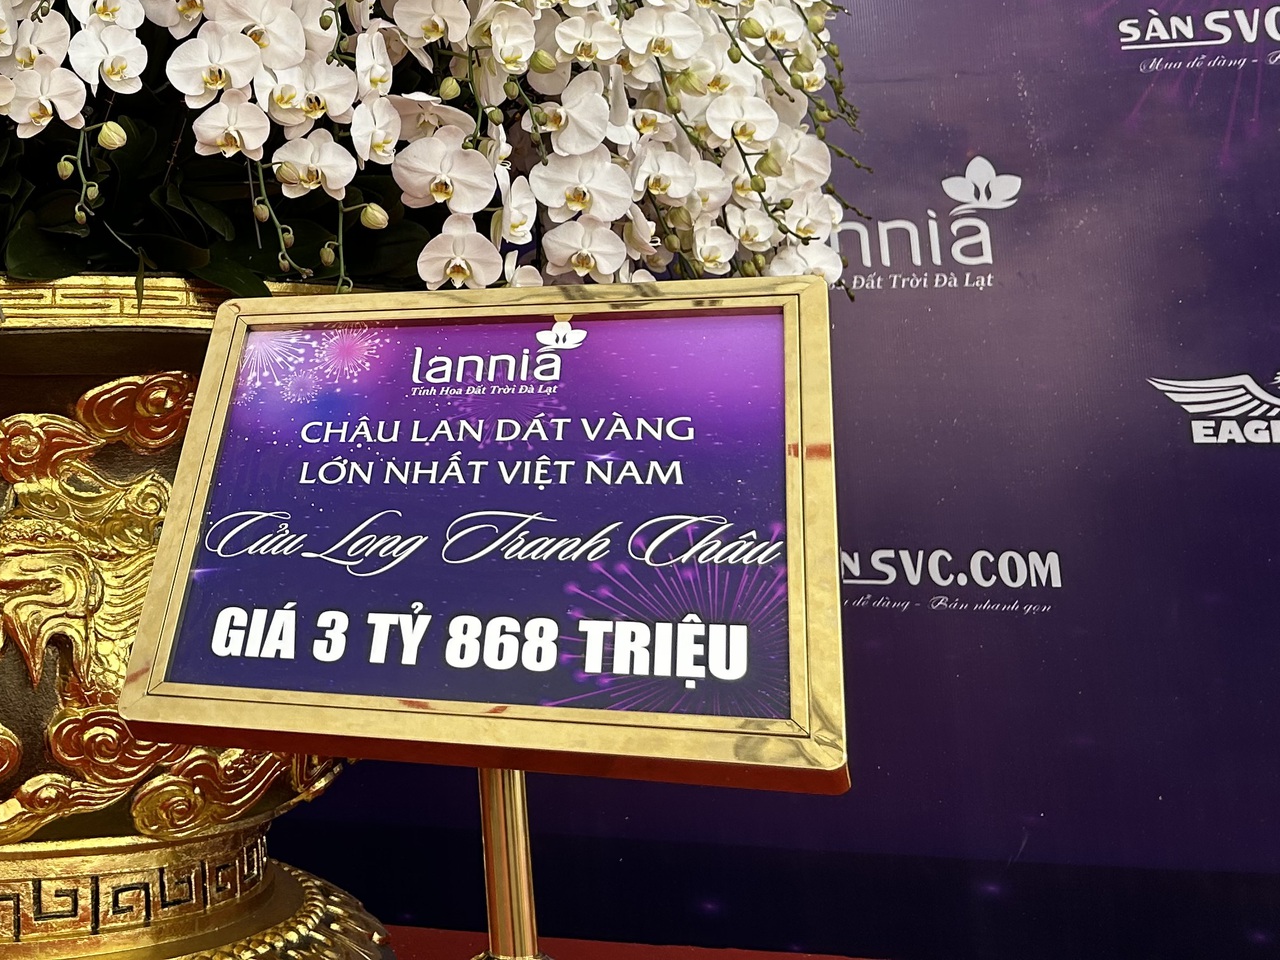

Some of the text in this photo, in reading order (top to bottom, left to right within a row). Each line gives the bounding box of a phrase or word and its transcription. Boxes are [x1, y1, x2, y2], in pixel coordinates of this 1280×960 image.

[1118, 8, 1194, 43] SÀN
[1139, 57, 1182, 74] Mua
[1186, 54, 1207, 69] dễ
[1207, 55, 1247, 70] dàng
[829, 209, 993, 268] nnia
[852, 271, 884, 290] Đất
[888, 272, 928, 289] Trời
[934, 271, 958, 288] Đà
[963, 271, 994, 291] Lạt
[411, 346, 562, 384] lannia
[439, 386, 462, 396] Hoa
[465, 384, 486, 396] Đất
[489, 384, 516, 395] Trời
[518, 383, 535, 394] Đà
[537, 384, 558, 395] Lạt
[411, 420, 483, 442] LAN
[496, 413, 571, 441] DÁT
[581, 412, 695, 441] VÀNG
[299, 451, 684, 490] LỚN NHẤT VIỆT NAM
[301, 510, 428, 577] Long
[627, 513, 784, 567] Châu
[870, 549, 1063, 588] SVC.COM
[872, 596, 910, 612] dàng
[927, 596, 968, 611] Bán
[973, 599, 1020, 612] nhanh
[1023, 604, 1052, 615] gọn
[212, 600, 749, 689] GIÁ 3 TỶ 868 TRIỆU
